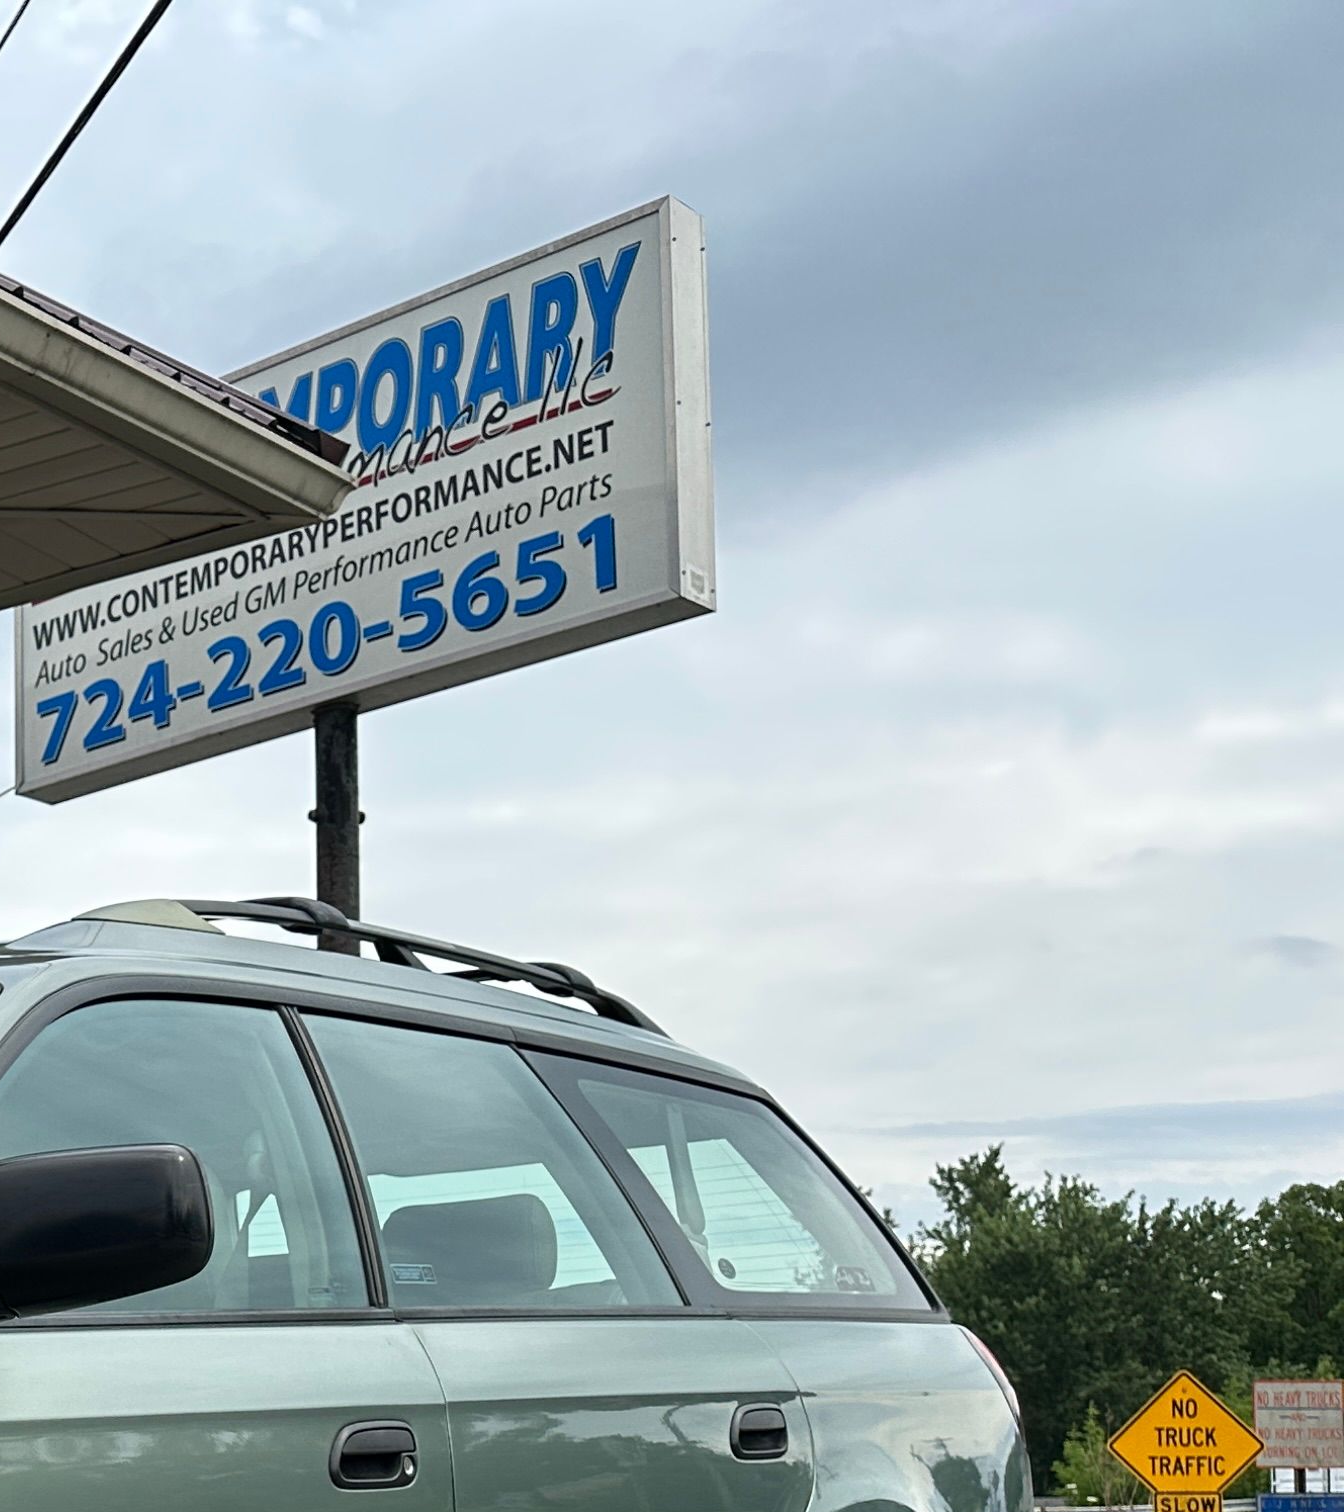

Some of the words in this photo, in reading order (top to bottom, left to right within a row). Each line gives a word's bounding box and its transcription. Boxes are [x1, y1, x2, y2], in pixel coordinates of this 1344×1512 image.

[33, 420, 614, 650] WWW.CONTEMPORARYPERFORMANCE.NET
[35, 653, 86, 688] Auto
[97, 628, 152, 666] Sales
[159, 617, 176, 644] &
[183, 592, 240, 636] Used
[245, 576, 286, 614] GM
[293, 525, 459, 600] Performance
[464, 501, 531, 543] Auto
[540, 473, 612, 517] Parts
[36, 513, 617, 766] 724-220-5651
[1172, 1398, 1198, 1419] NO
[1306, 1391, 1340, 1408] TRUCKS
[1155, 1427, 1217, 1447] TRUCK
[1148, 1456, 1225, 1476] TRAFFIC
